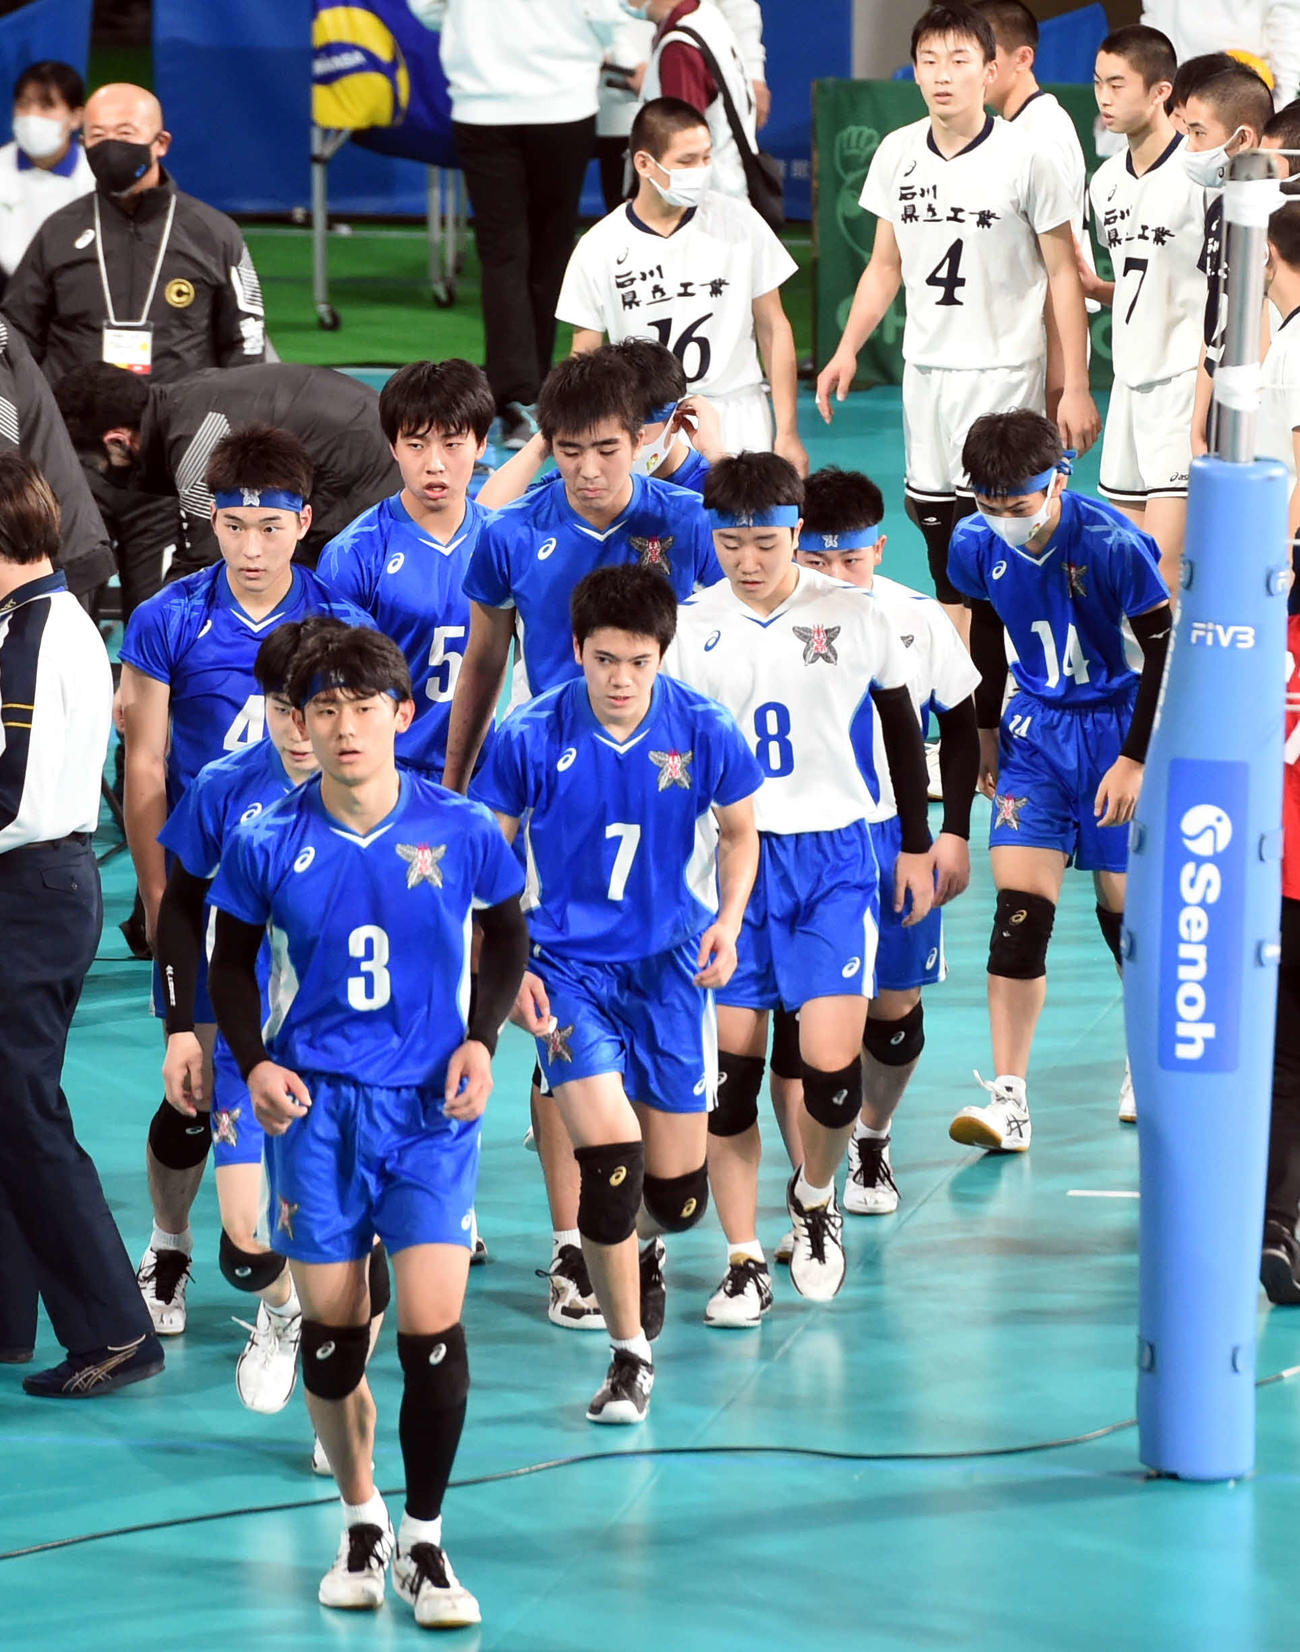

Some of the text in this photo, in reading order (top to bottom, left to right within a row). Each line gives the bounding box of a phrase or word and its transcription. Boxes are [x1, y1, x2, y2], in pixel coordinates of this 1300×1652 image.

[899, 184, 937, 202] 石川
[901, 203, 1001, 229] 県立工業
[615, 264, 664, 289] 石川
[621, 278, 730, 311] 県立工業
[925, 238, 966, 306] 4
[1122, 257, 1149, 325] 7
[647, 312, 714, 384] 16
[425, 625, 465, 703] 5
[1030, 619, 1090, 689] 14
[223, 695, 269, 752] 4
[753, 701, 795, 778] 8
[605, 822, 641, 901] 7
[347, 924, 391, 1012] 3
[1174, 861, 1222, 1061] Senoh
